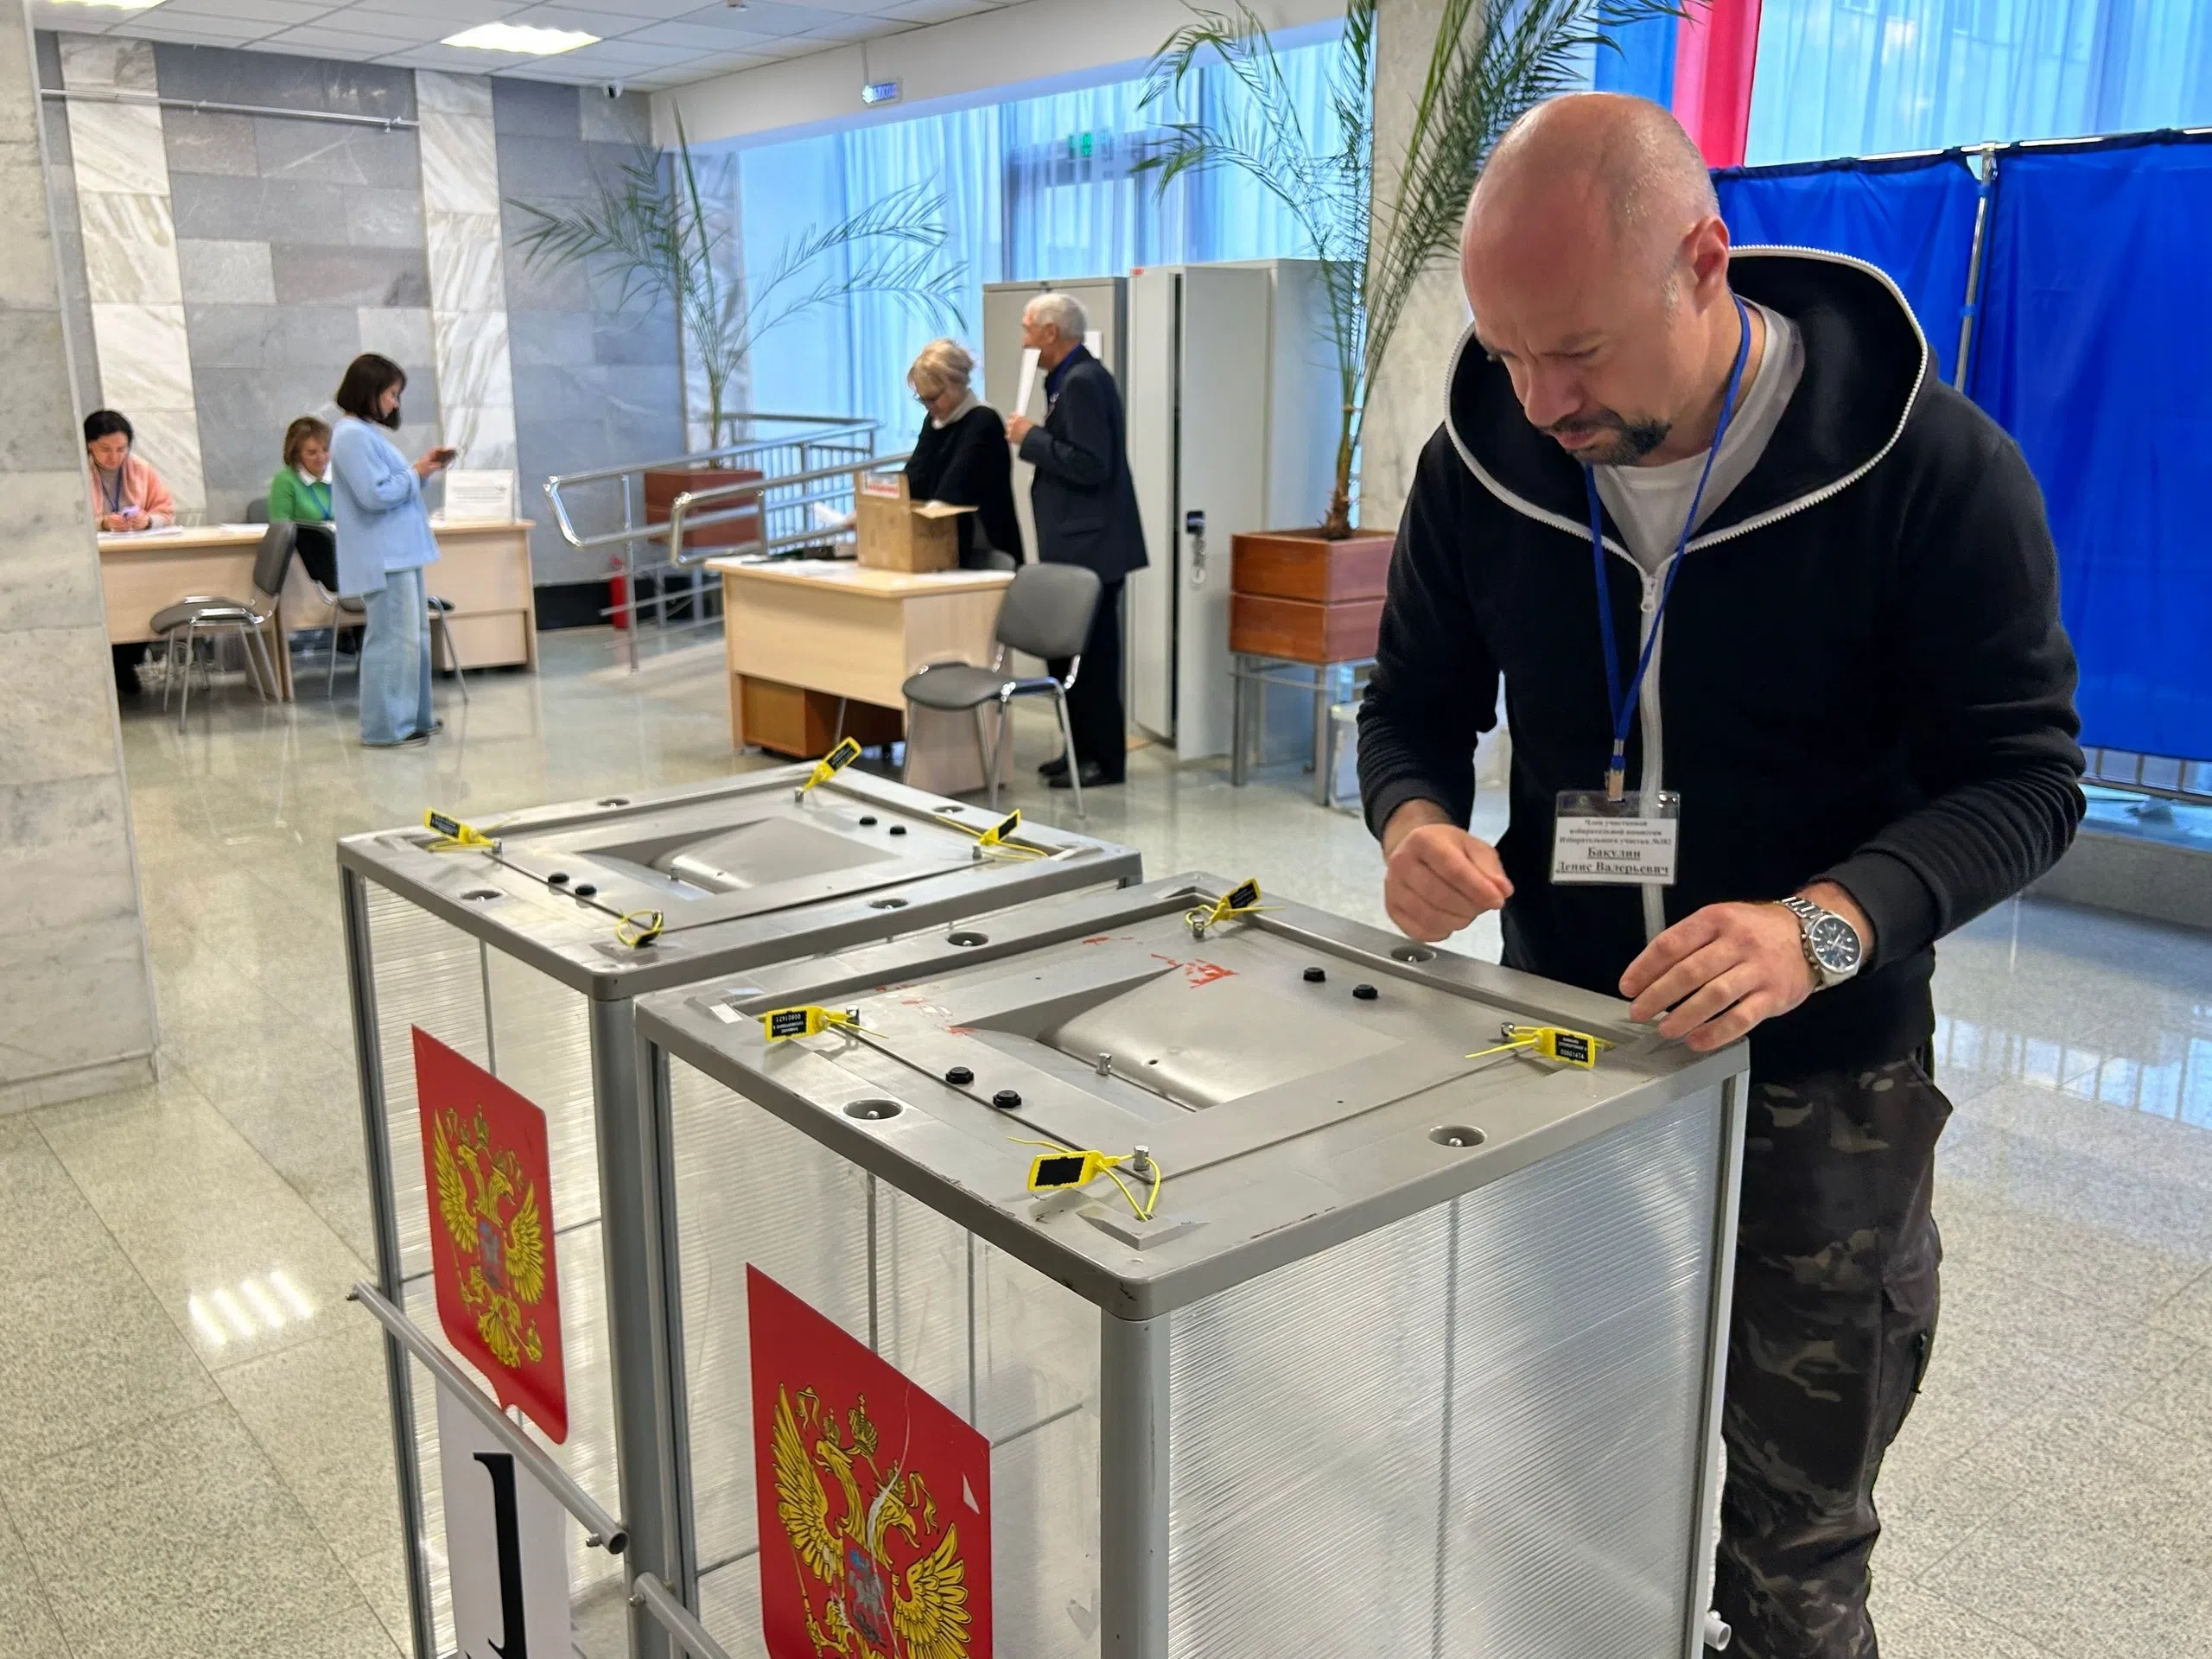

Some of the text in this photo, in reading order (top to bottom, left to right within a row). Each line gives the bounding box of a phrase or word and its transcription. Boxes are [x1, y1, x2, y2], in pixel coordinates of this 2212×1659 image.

[1588, 847, 1641, 859] Бакулин
[1555, 861, 1668, 874] Денис Валерьевич
